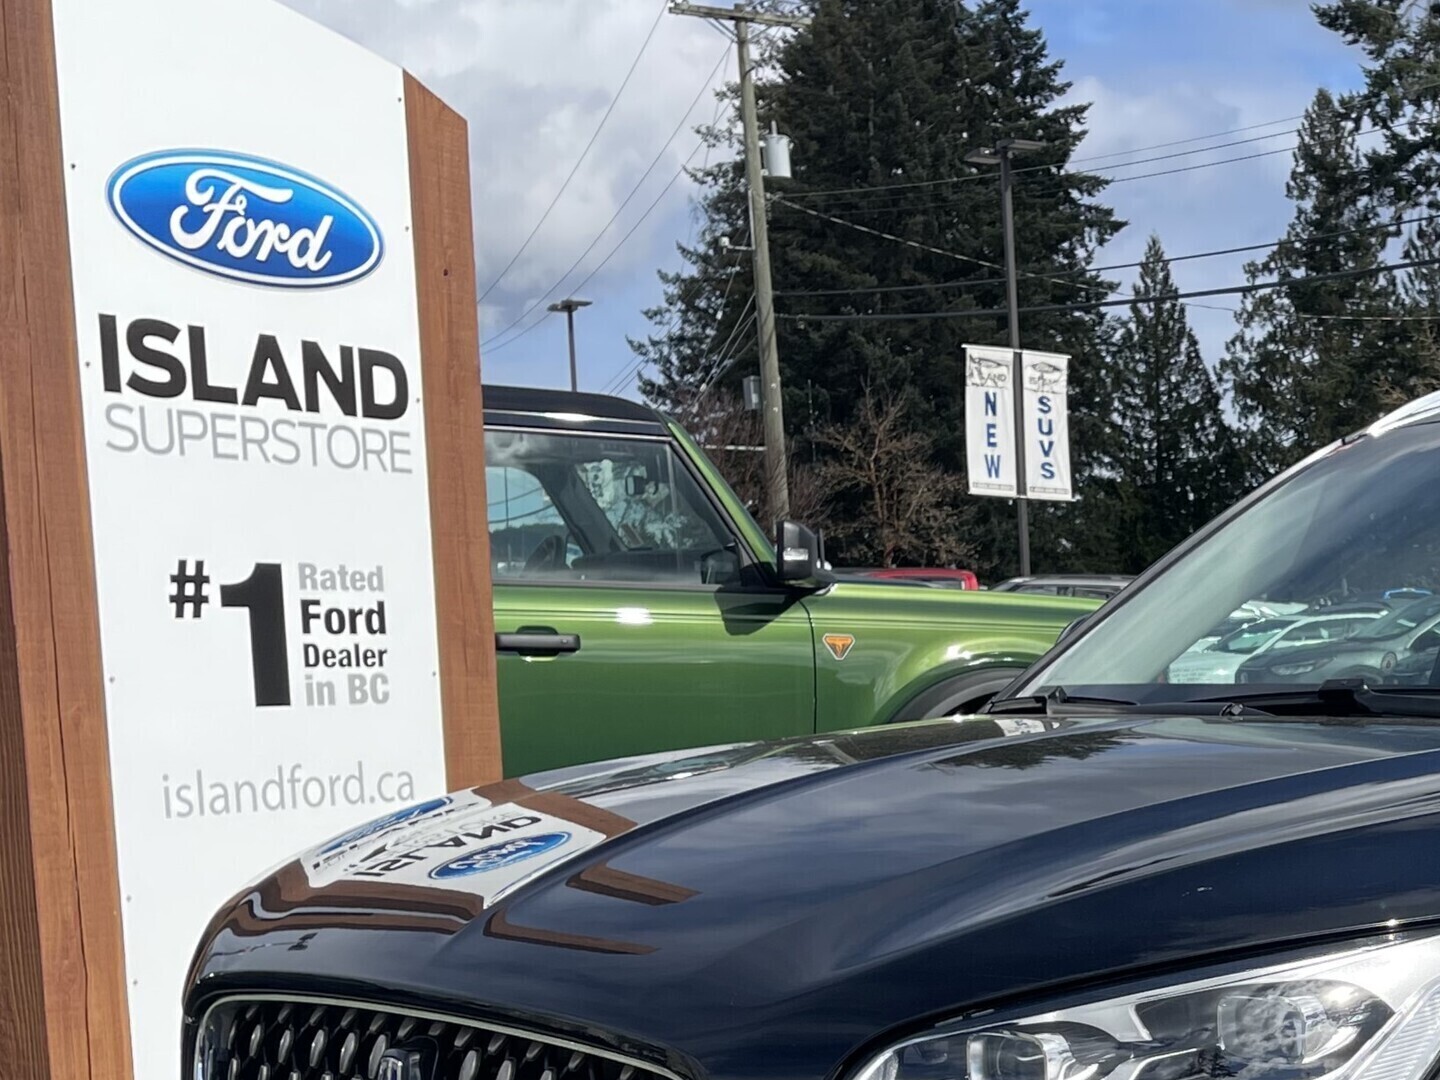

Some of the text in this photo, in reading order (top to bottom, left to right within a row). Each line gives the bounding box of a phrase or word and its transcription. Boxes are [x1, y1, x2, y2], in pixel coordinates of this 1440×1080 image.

[169, 167, 332, 273] Ford
[98, 313, 409, 421] ISLAND
[103, 403, 413, 474] SUPERSTORE
[984, 391, 1000, 479] NEW
[1037, 395, 1056, 480] SUVS
[298, 562, 384, 593] Rated
[170, 560, 292, 707] #1
[301, 600, 387, 635] Ford
[303, 642, 388, 669] Dealer
[305, 673, 390, 707] in BC
[162, 761, 415, 819] islandford.ca
